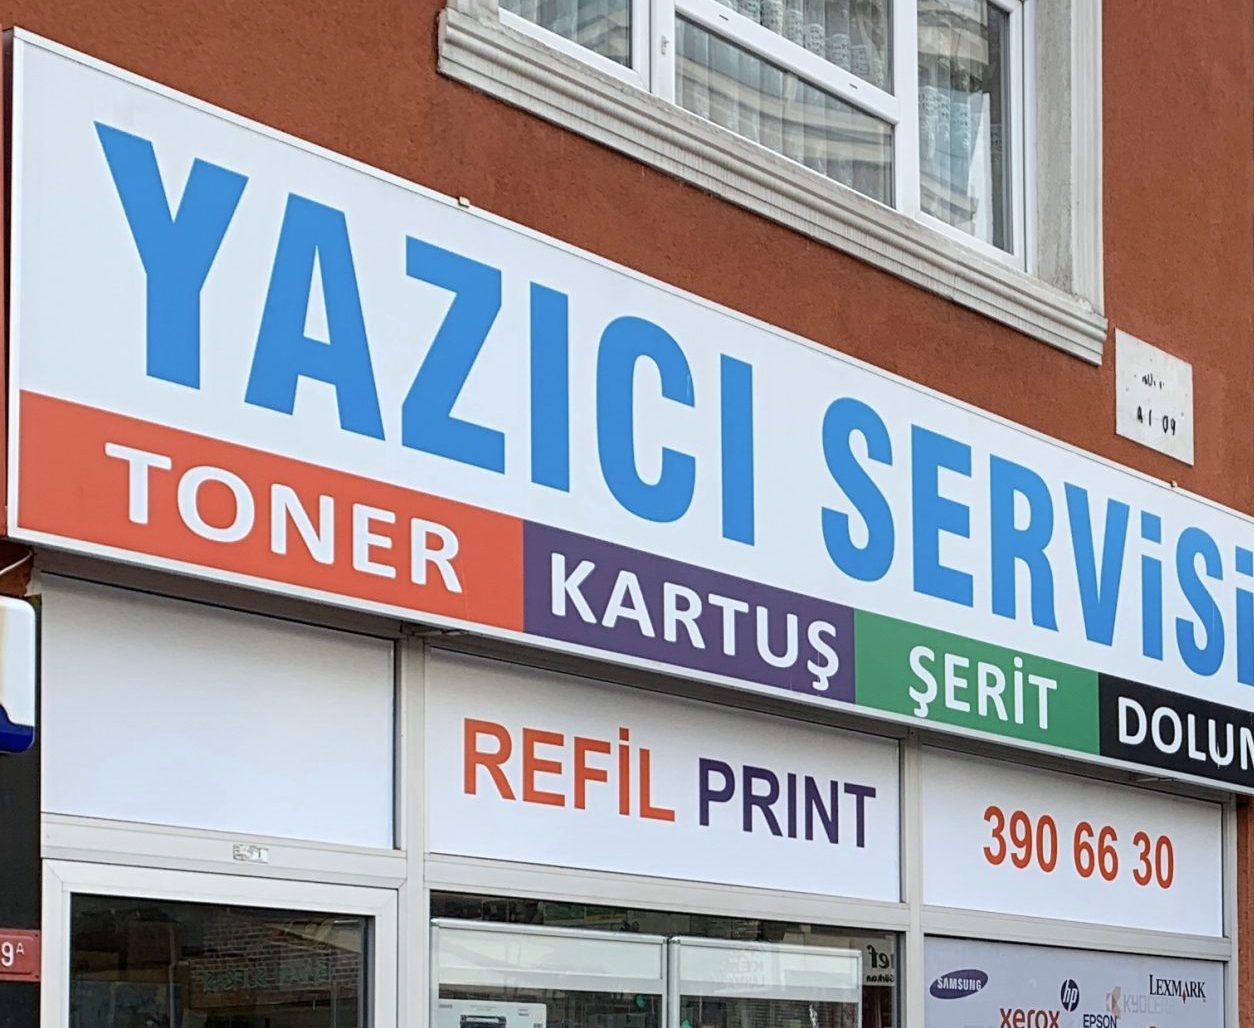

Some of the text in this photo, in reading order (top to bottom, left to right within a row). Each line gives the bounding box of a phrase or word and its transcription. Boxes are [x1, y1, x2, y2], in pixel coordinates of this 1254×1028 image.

[93, 121, 754, 546] YAZICI
[104, 442, 462, 593] TONER
[551, 553, 840, 691] KARTUŞ
[908, 645, 1057, 730] ŞERİT
[699, 757, 877, 848] PRINT
[983, 805, 1174, 890] 390 66 30
[937, 977, 982, 991] SAMSUNG
[1062, 979, 1078, 1011] hp
[1149, 975, 1205, 1002] LEXMARK
[1083, 1014, 1117, 1028] EPSON
